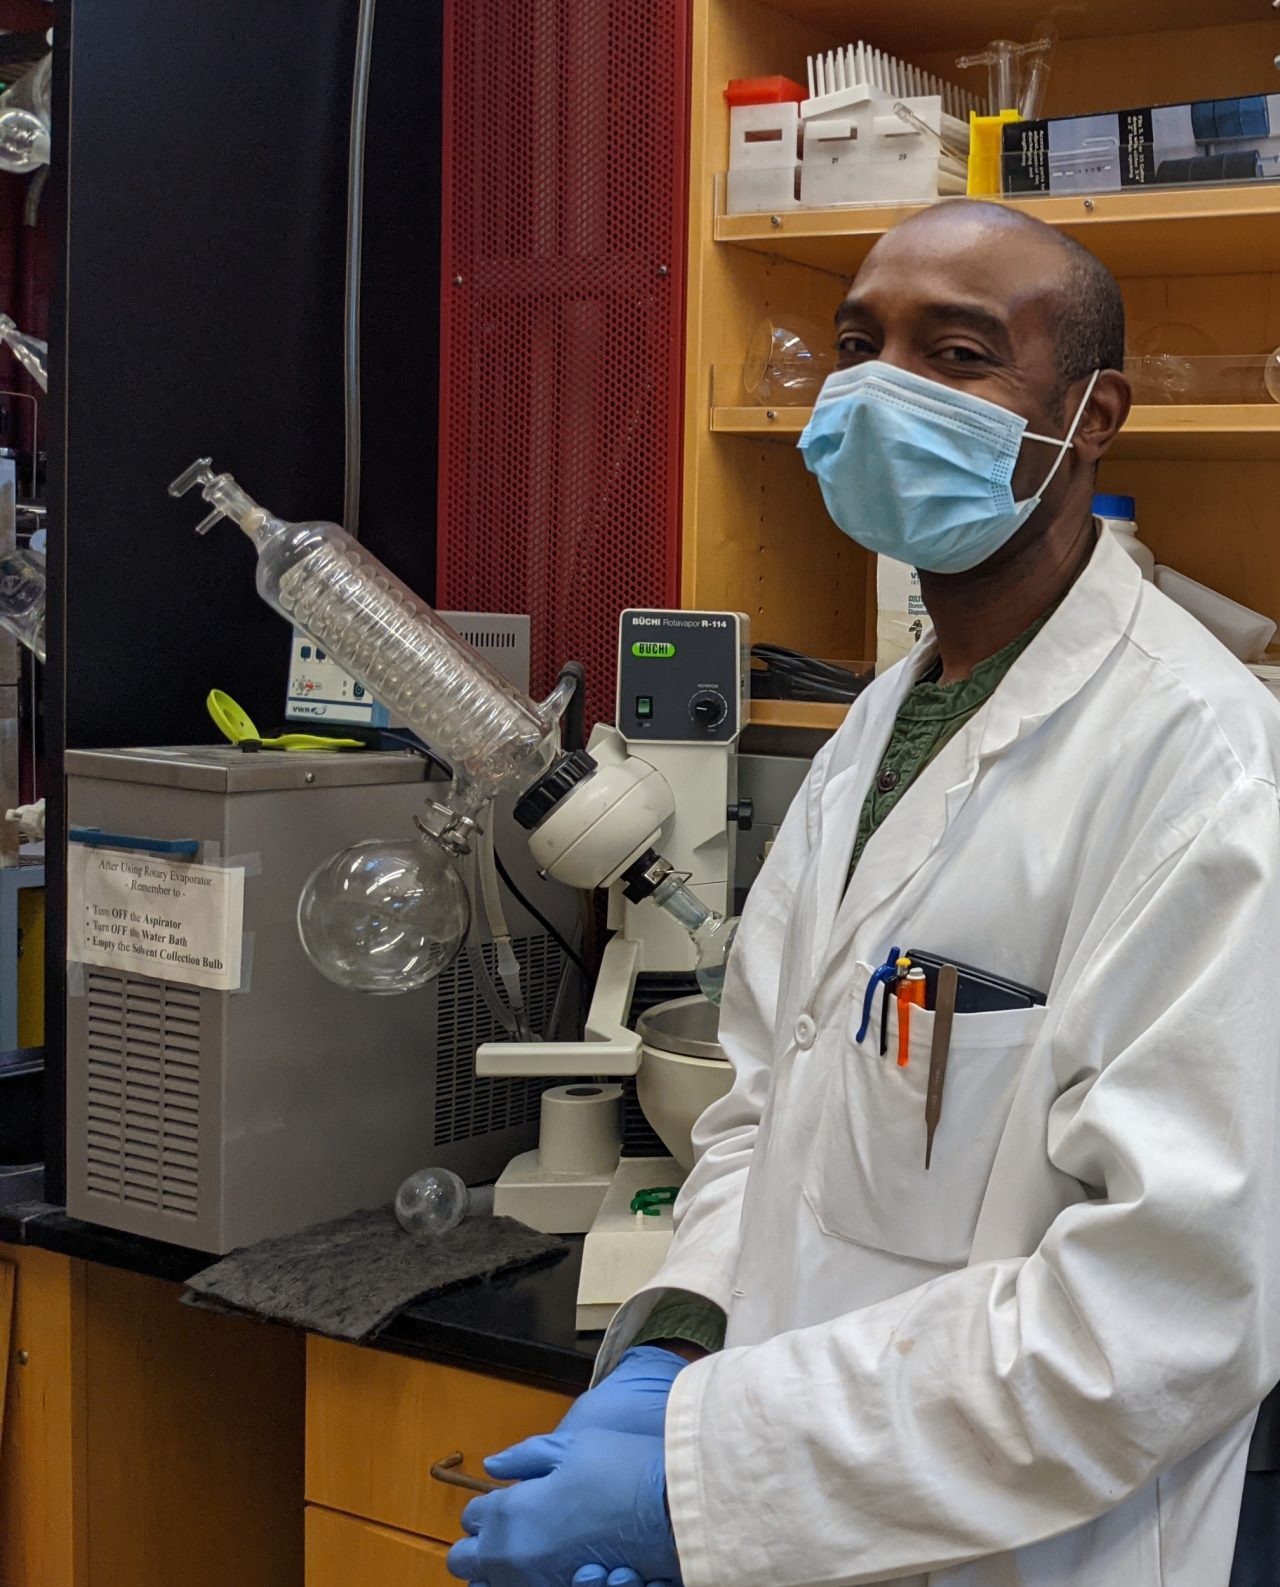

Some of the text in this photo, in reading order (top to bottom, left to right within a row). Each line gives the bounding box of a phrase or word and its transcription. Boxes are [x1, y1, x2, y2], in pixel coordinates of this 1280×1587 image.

[632, 617, 660, 625] BÜCHI
[663, 619, 700, 627] Rotavapor
[98, 860, 212, 886] After Using Rotary Evaporator
[131, 880, 180, 897] Remember to
[93, 904, 182, 930] Turn OFF the Aspirator
[93, 920, 188, 947] Turn OFF the Water Bath
[92, 935, 223, 970] Empty the Solvent Collection Bulb
